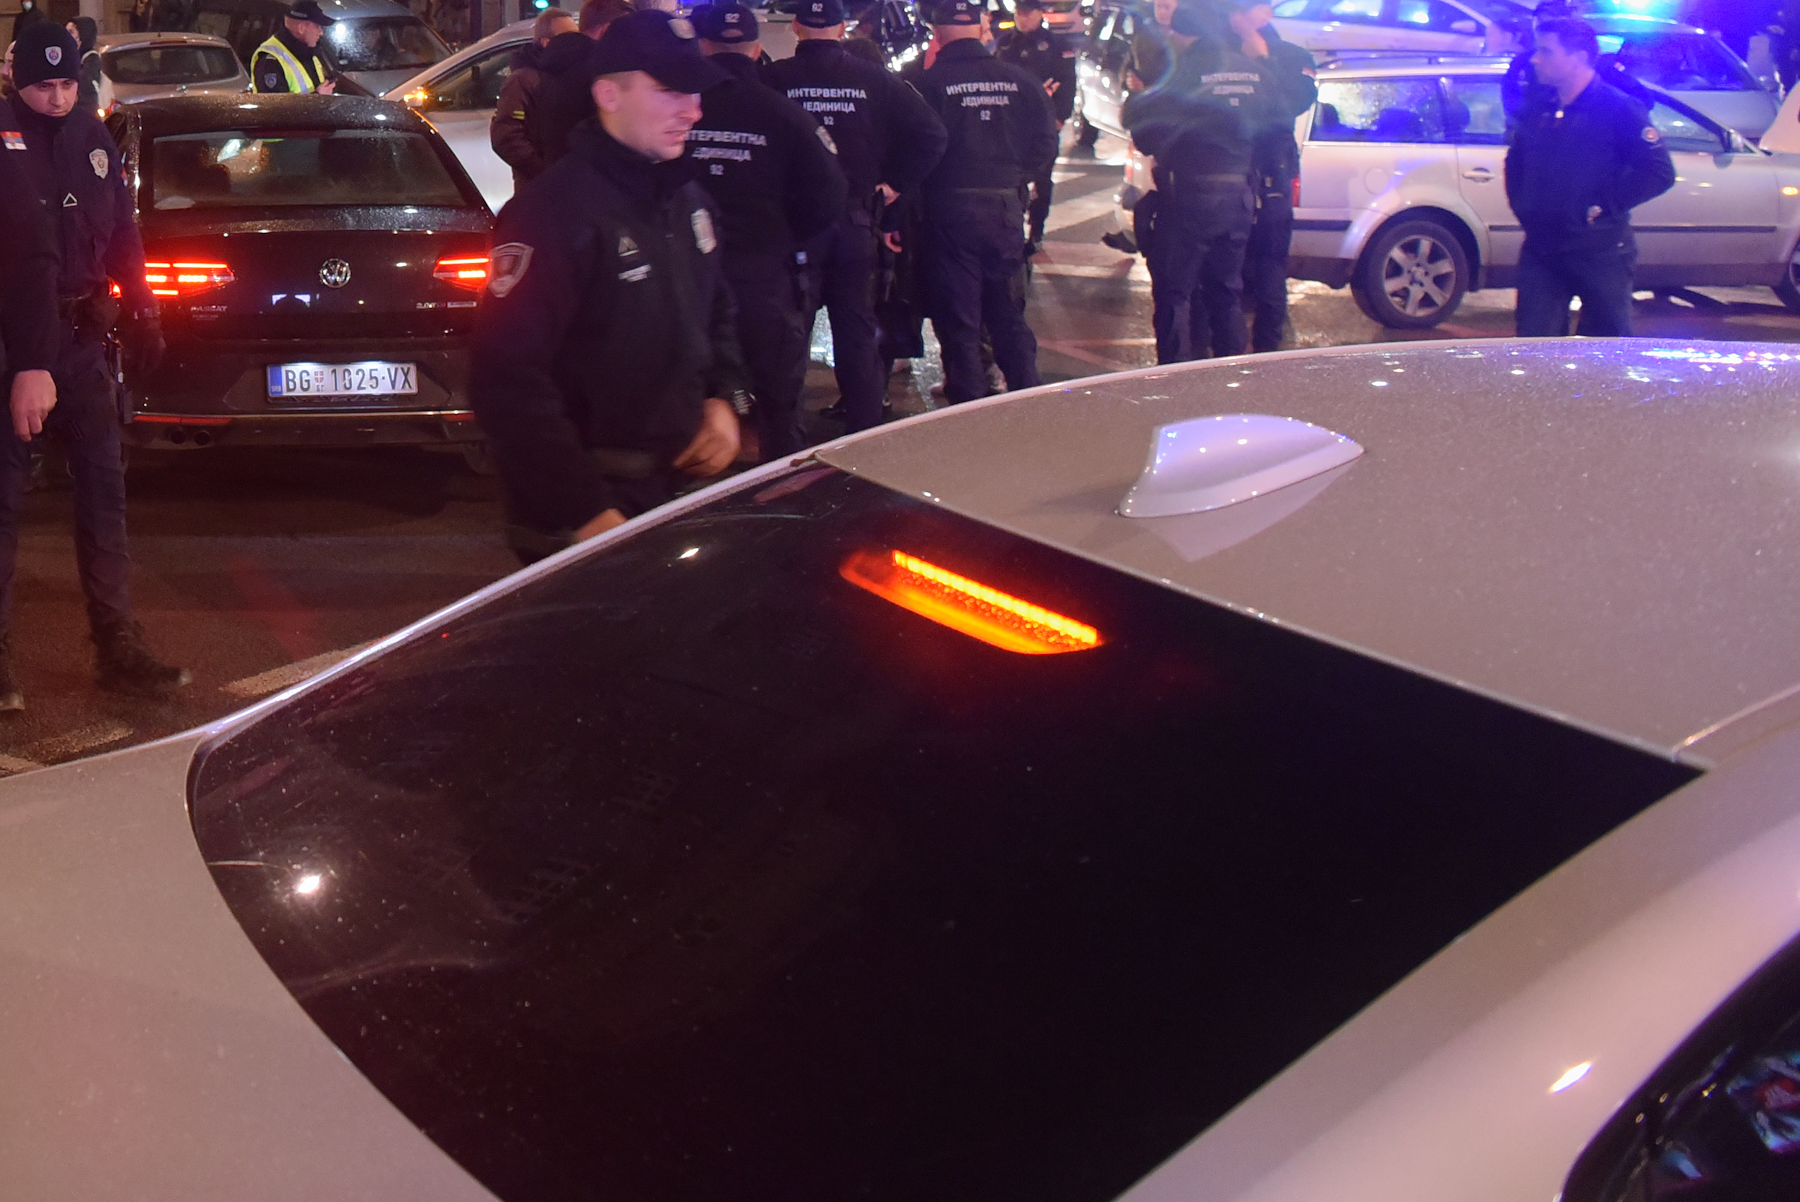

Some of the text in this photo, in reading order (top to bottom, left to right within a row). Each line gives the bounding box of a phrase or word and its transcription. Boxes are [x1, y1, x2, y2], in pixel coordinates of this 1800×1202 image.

[811, 2, 824, 12] 92
[786, 87, 867, 99] ИНТЕРВЕНТНА
[945, 81, 1019, 95] ИНТЕРВЕНТНА
[823, 116, 835, 126] 92
[685, 129, 768, 146] НТЕРВЕНТНА
[284, 369, 312, 393] BG
